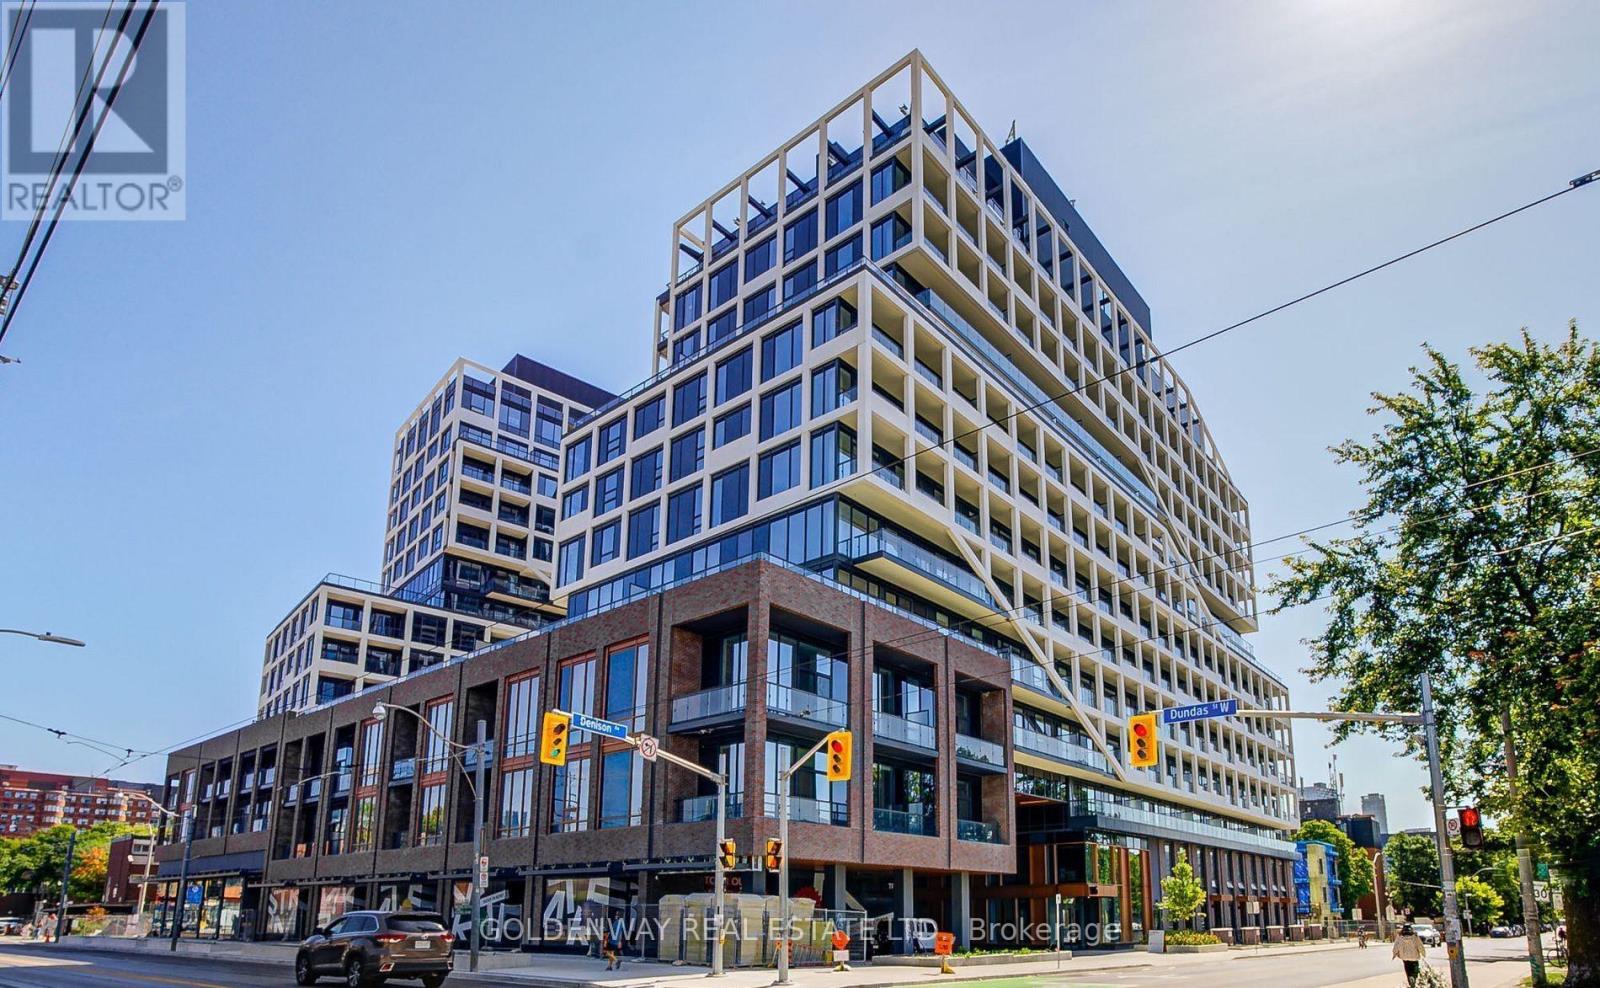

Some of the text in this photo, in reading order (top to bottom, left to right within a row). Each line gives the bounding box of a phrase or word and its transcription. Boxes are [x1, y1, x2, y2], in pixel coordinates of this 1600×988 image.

[1170, 706, 1209, 720] Dundas
[1220, 702, 1229, 712] W
[580, 717, 612, 733] Denison
[1534, 889, 1547, 898] 30
